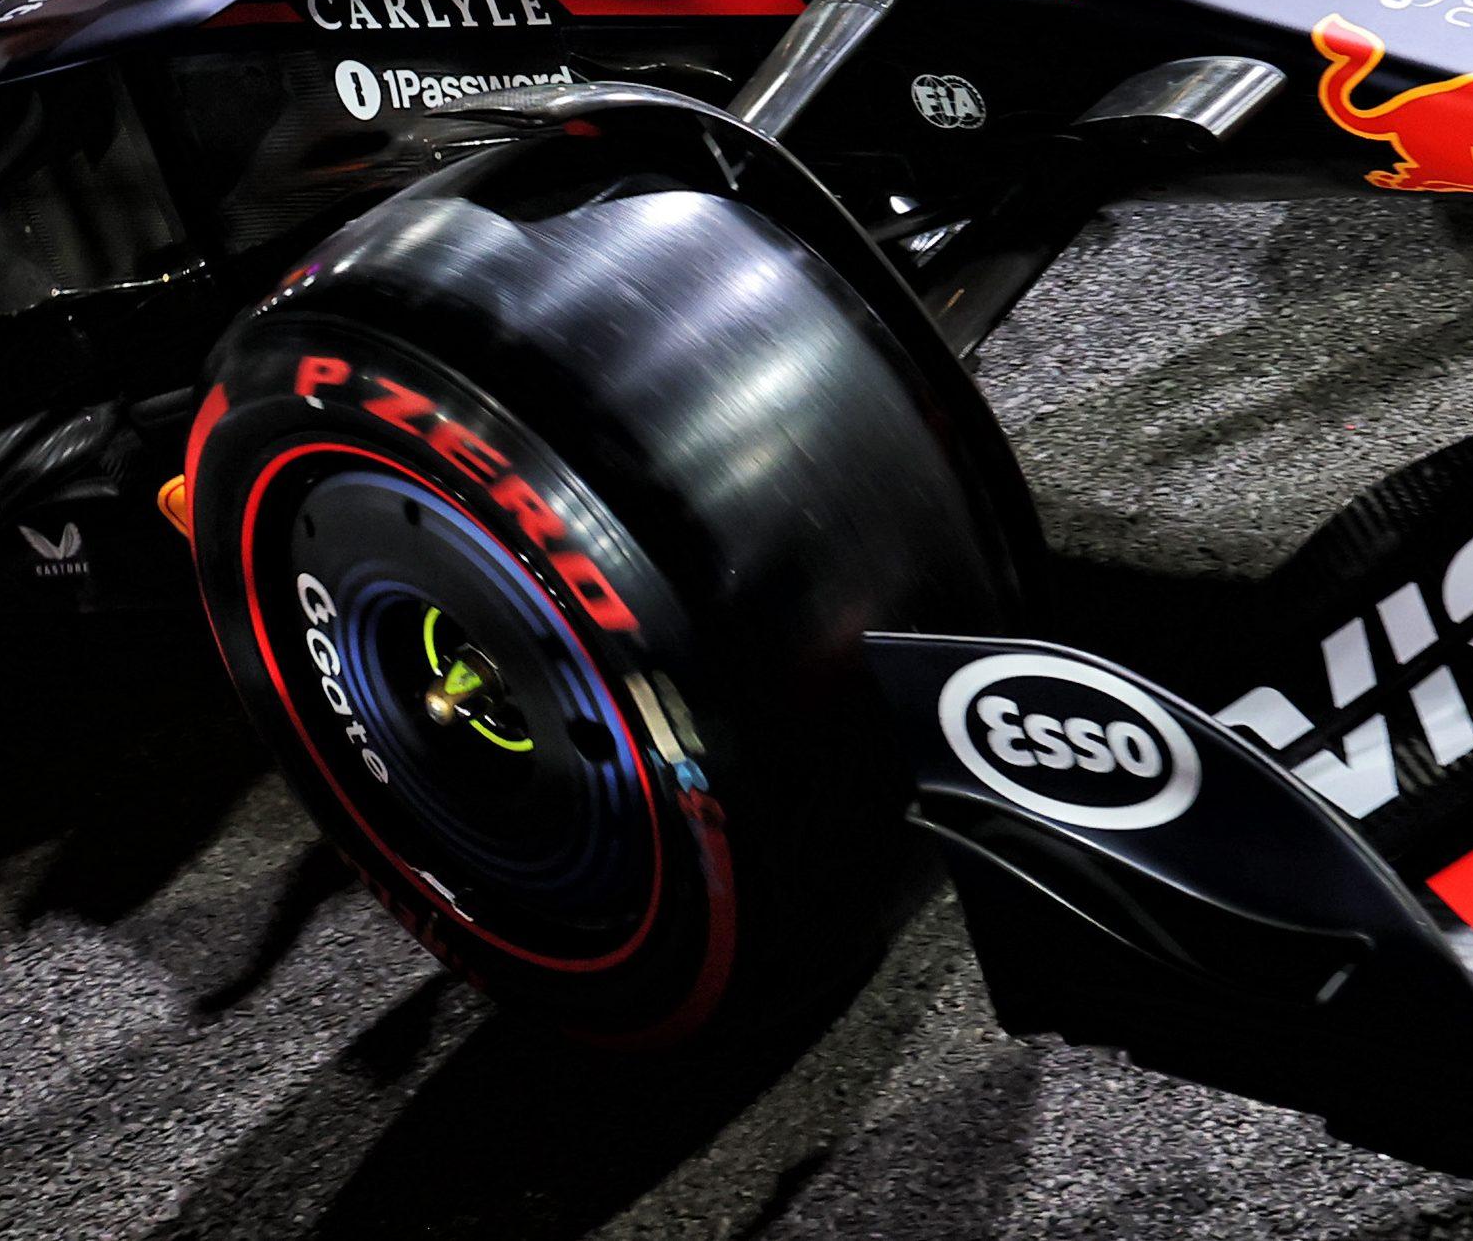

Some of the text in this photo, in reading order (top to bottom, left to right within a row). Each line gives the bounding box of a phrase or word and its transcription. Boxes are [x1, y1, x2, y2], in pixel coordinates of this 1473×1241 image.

[294, 356, 642, 636] P ZERO
[305, 627, 389, 785] Gate
